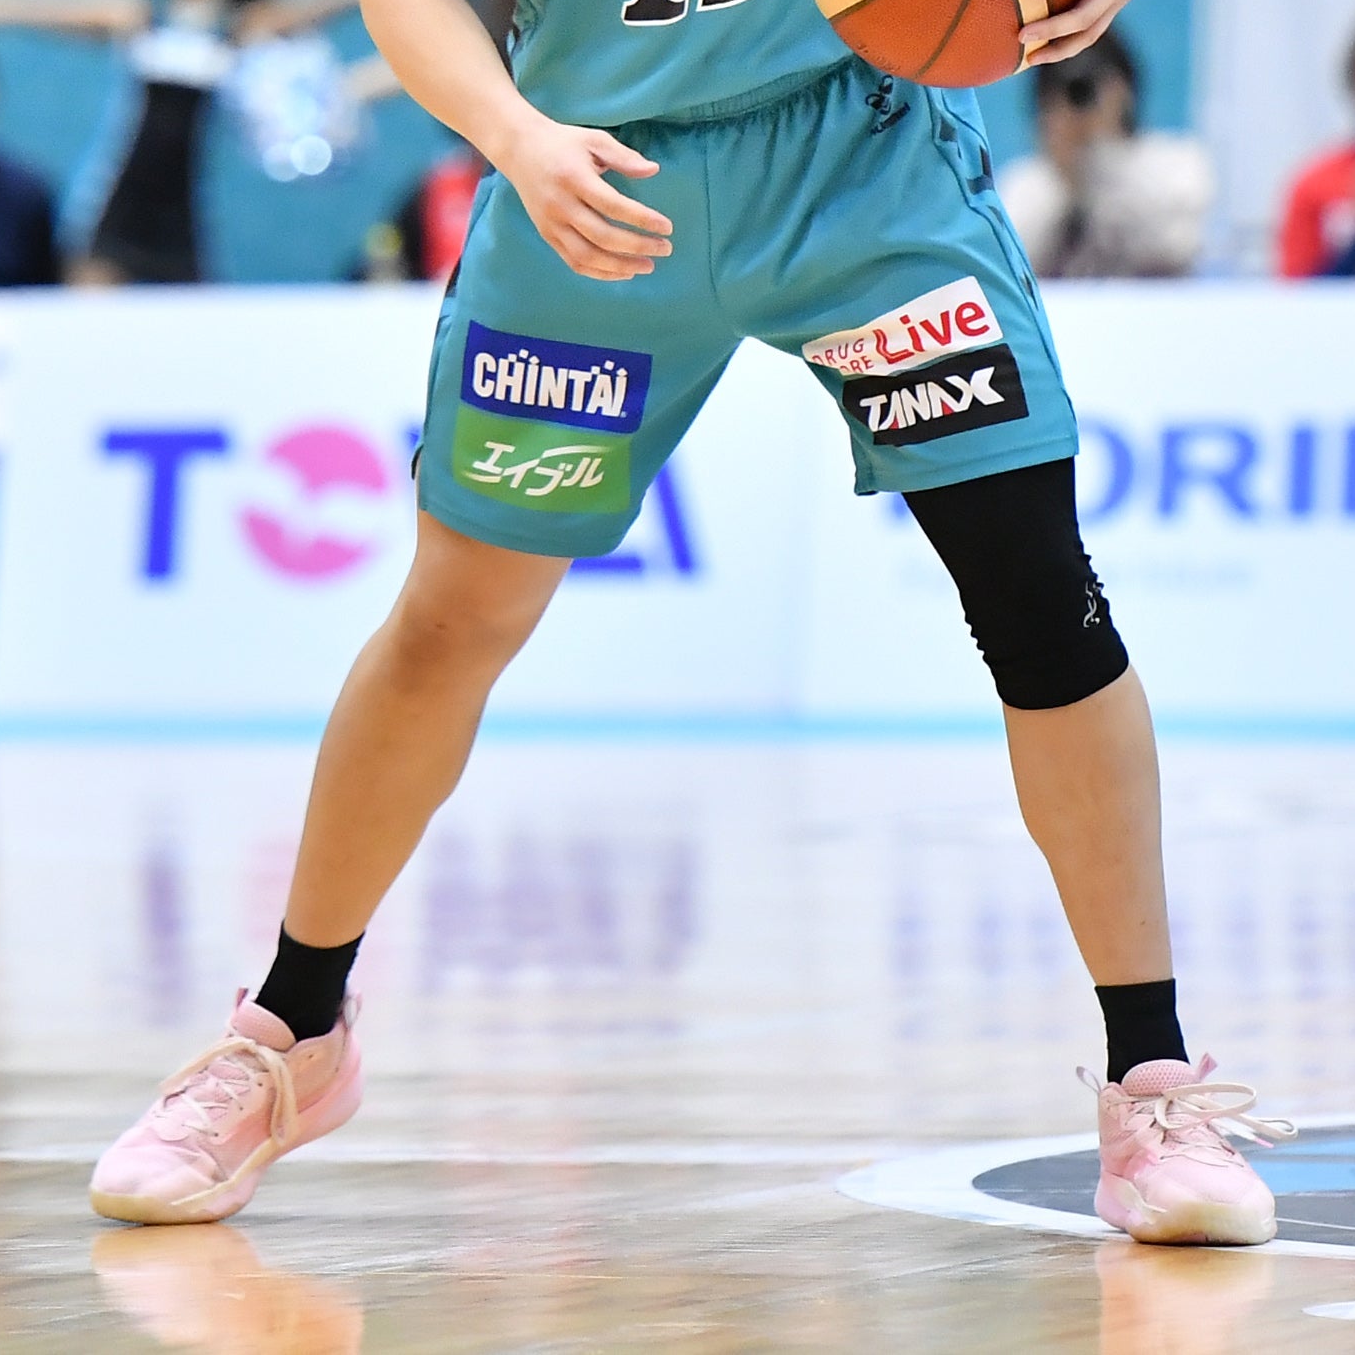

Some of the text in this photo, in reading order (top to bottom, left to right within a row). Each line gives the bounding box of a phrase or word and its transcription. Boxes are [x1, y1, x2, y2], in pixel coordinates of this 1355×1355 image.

[873, 301, 991, 365] Live
[859, 366, 1006, 433] TANAX
[471, 441, 608, 497] エイブル
